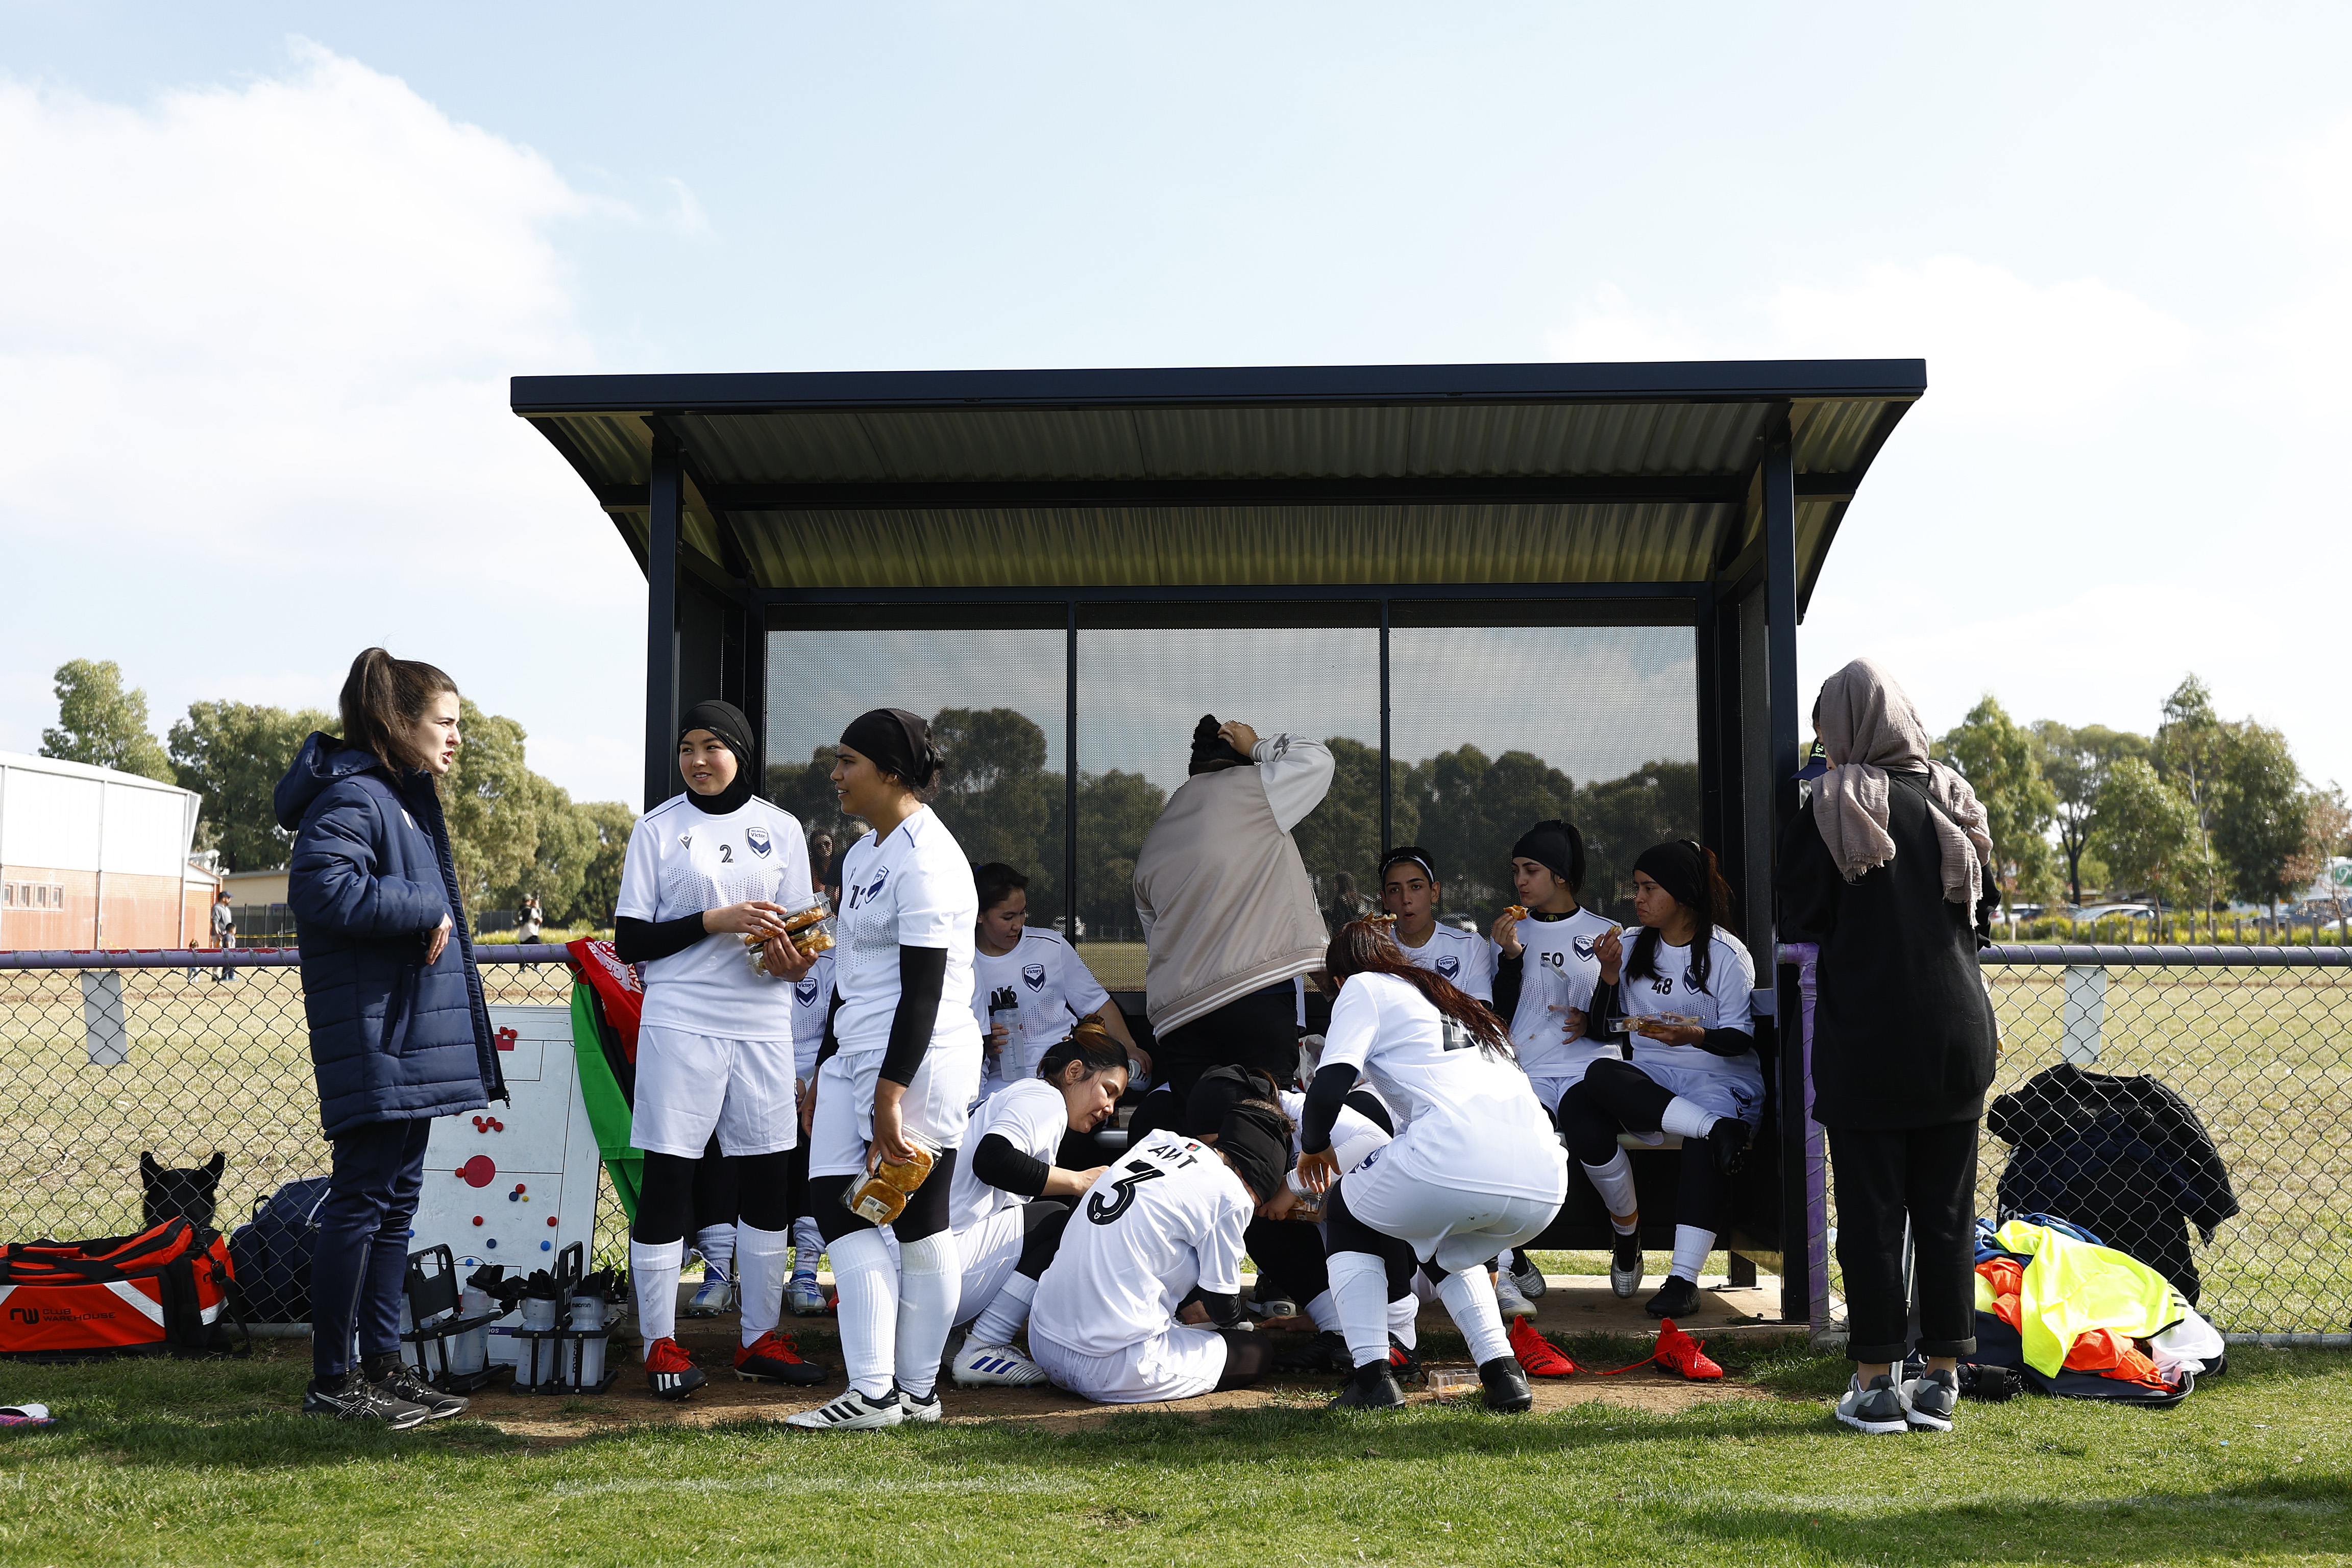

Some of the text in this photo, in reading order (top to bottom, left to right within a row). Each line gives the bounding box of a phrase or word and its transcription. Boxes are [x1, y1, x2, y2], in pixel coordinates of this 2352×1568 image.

[719, 844, 734, 863] 2
[1540, 952, 1564, 968] 50
[1651, 978, 1673, 995] 48
[1087, 1159, 1166, 1226] 3
[42, 1311, 116, 1322] WAREHOUSE
